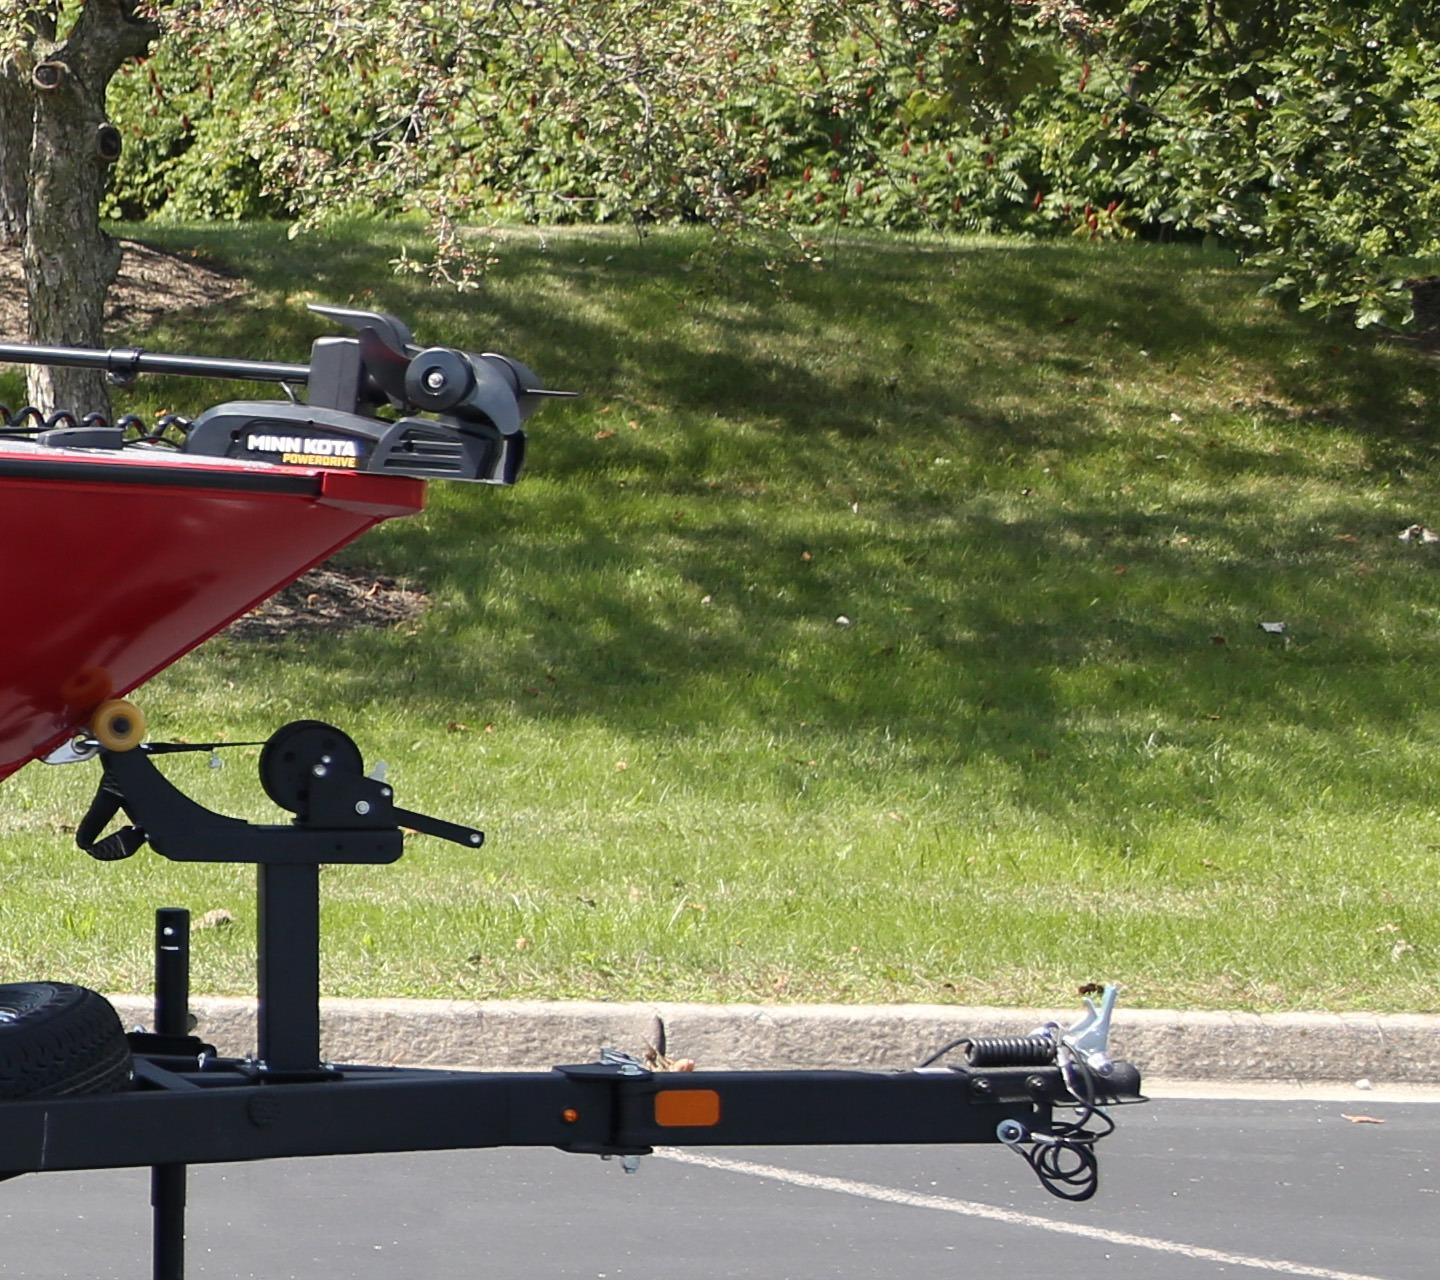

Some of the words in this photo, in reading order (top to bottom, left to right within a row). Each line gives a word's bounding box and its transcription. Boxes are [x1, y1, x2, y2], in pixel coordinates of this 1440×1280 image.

[248, 434, 301, 452] MINN
[304, 438, 356, 456] KOTA
[282, 453, 357, 467] POWERDRIVE
